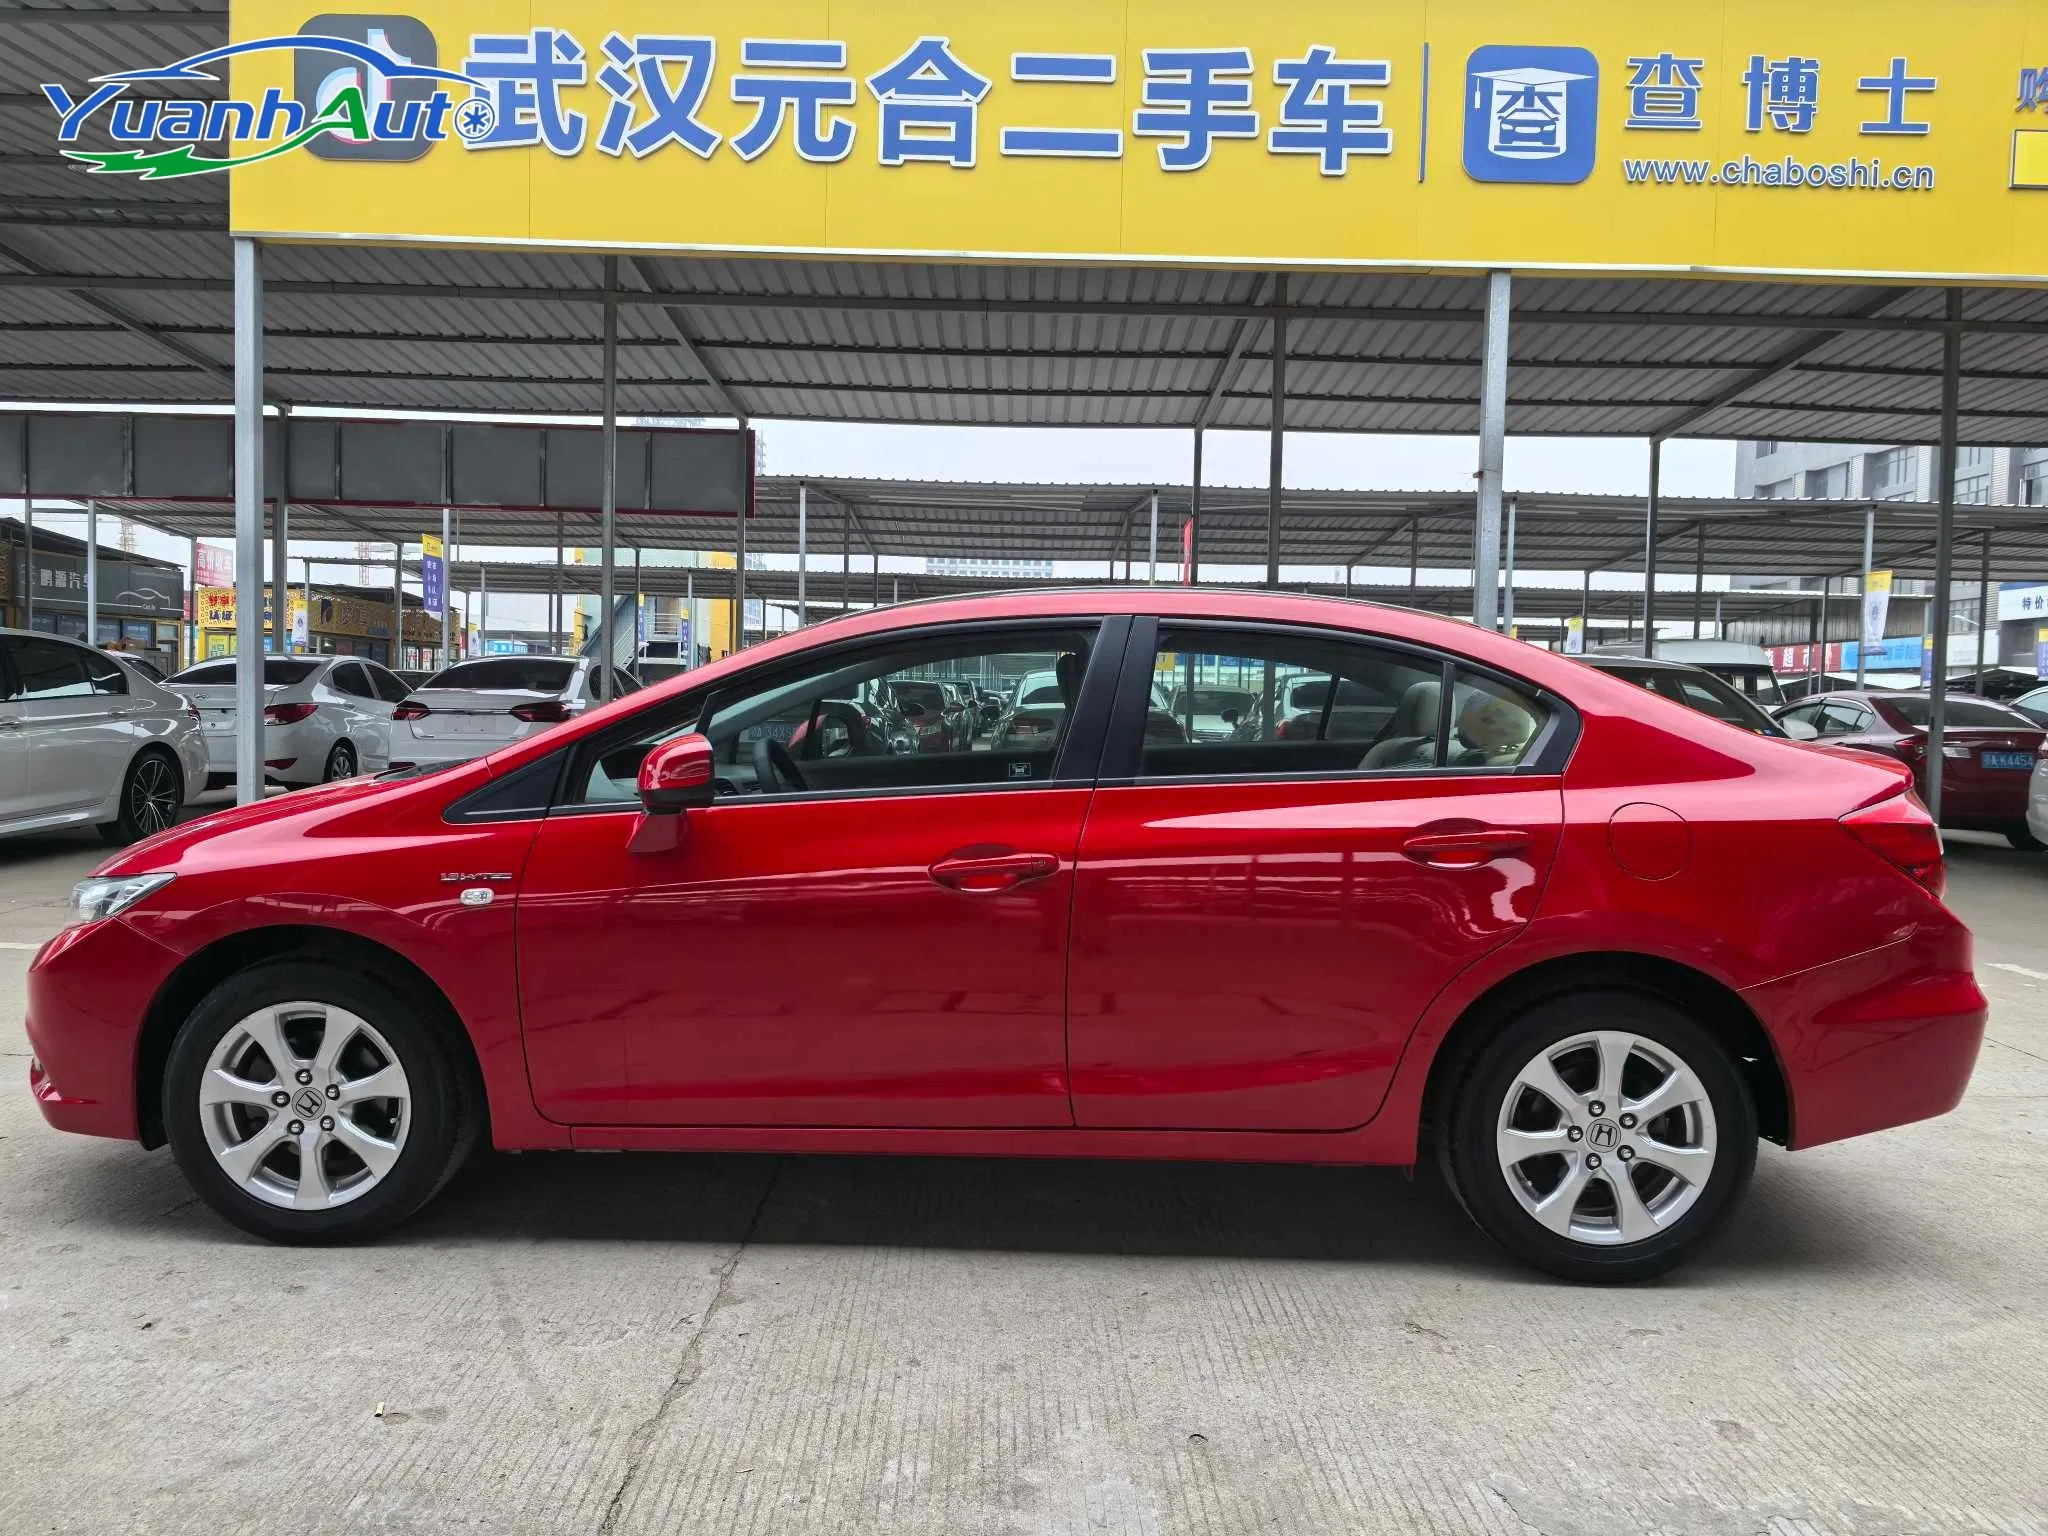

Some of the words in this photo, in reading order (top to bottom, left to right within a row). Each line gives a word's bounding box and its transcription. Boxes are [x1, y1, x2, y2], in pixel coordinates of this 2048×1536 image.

[461, 26, 1393, 178] 武汉元合二手车
[1623, 51, 1937, 136] 查博士
[1623, 152, 1936, 190] www.chaboshi.cn
[2022, 595, 2048, 611] 特价
